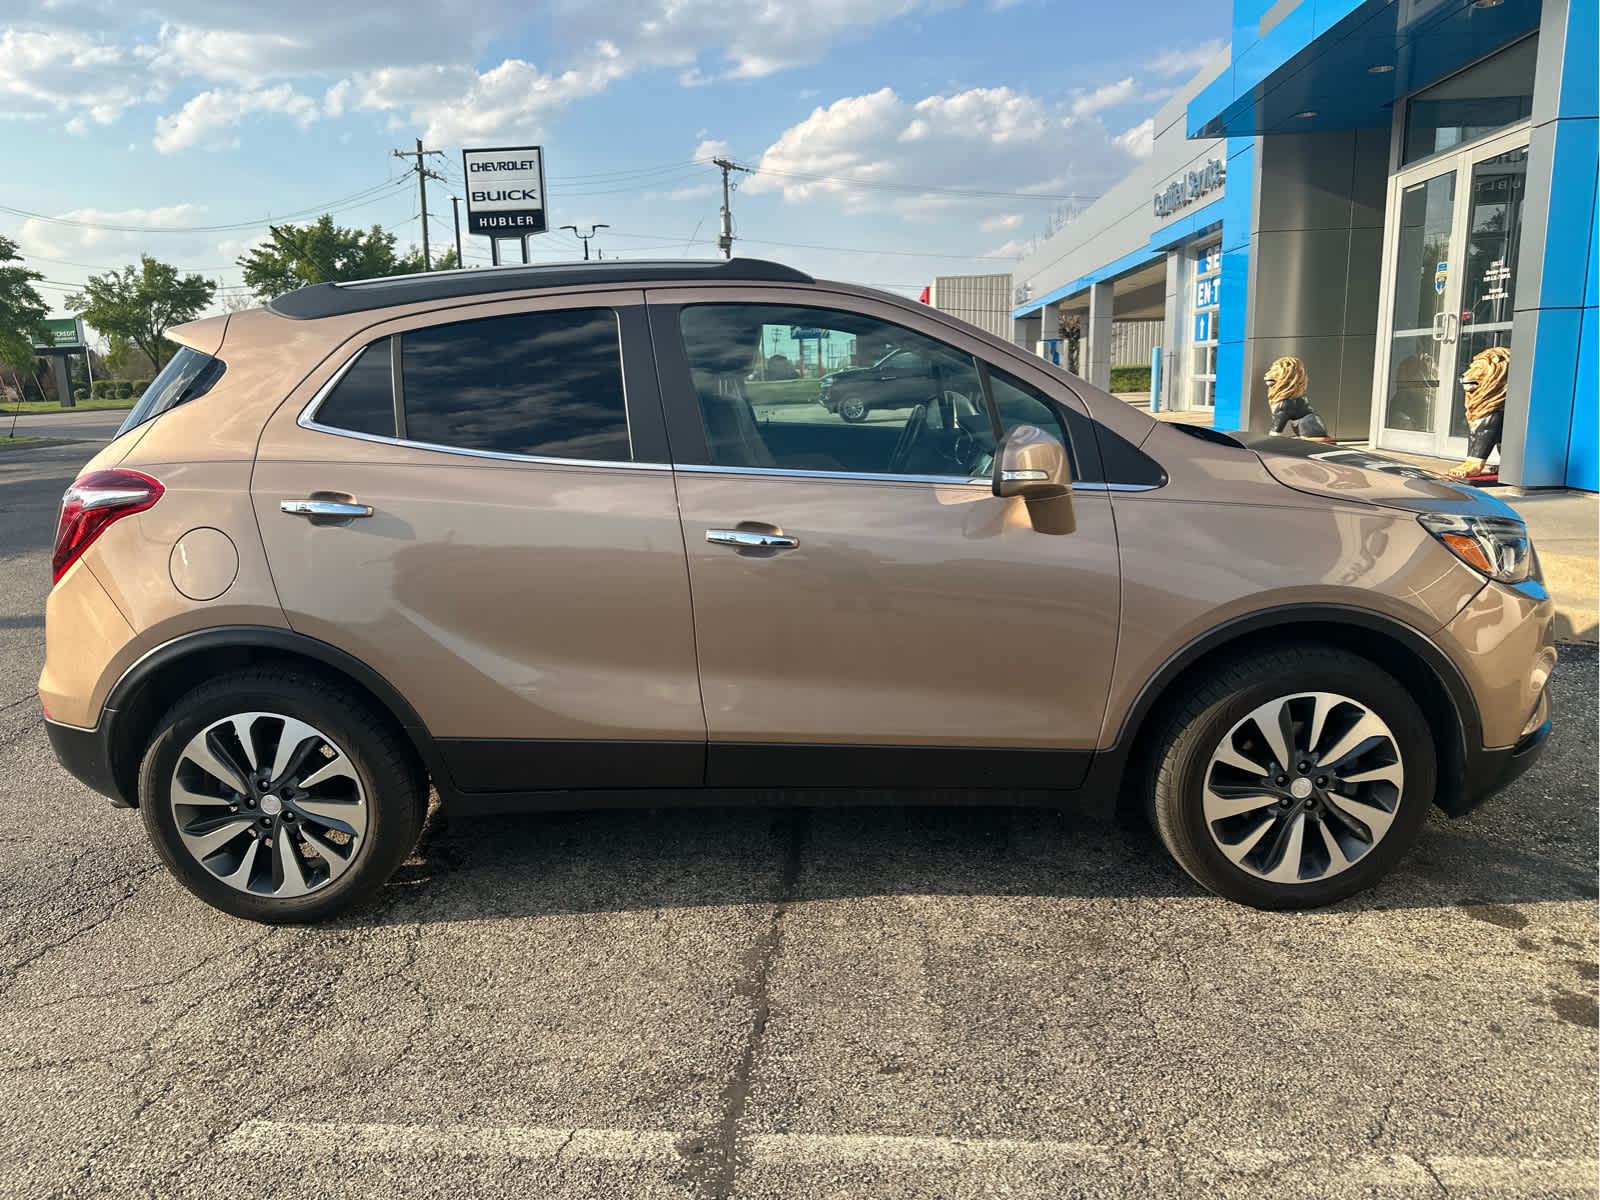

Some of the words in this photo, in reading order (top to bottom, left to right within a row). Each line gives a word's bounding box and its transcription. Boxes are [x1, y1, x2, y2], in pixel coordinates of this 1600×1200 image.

[470, 160, 534, 172] CHEVROLET
[472, 189, 537, 202] BUICK
[479, 216, 534, 227] HUBLER
